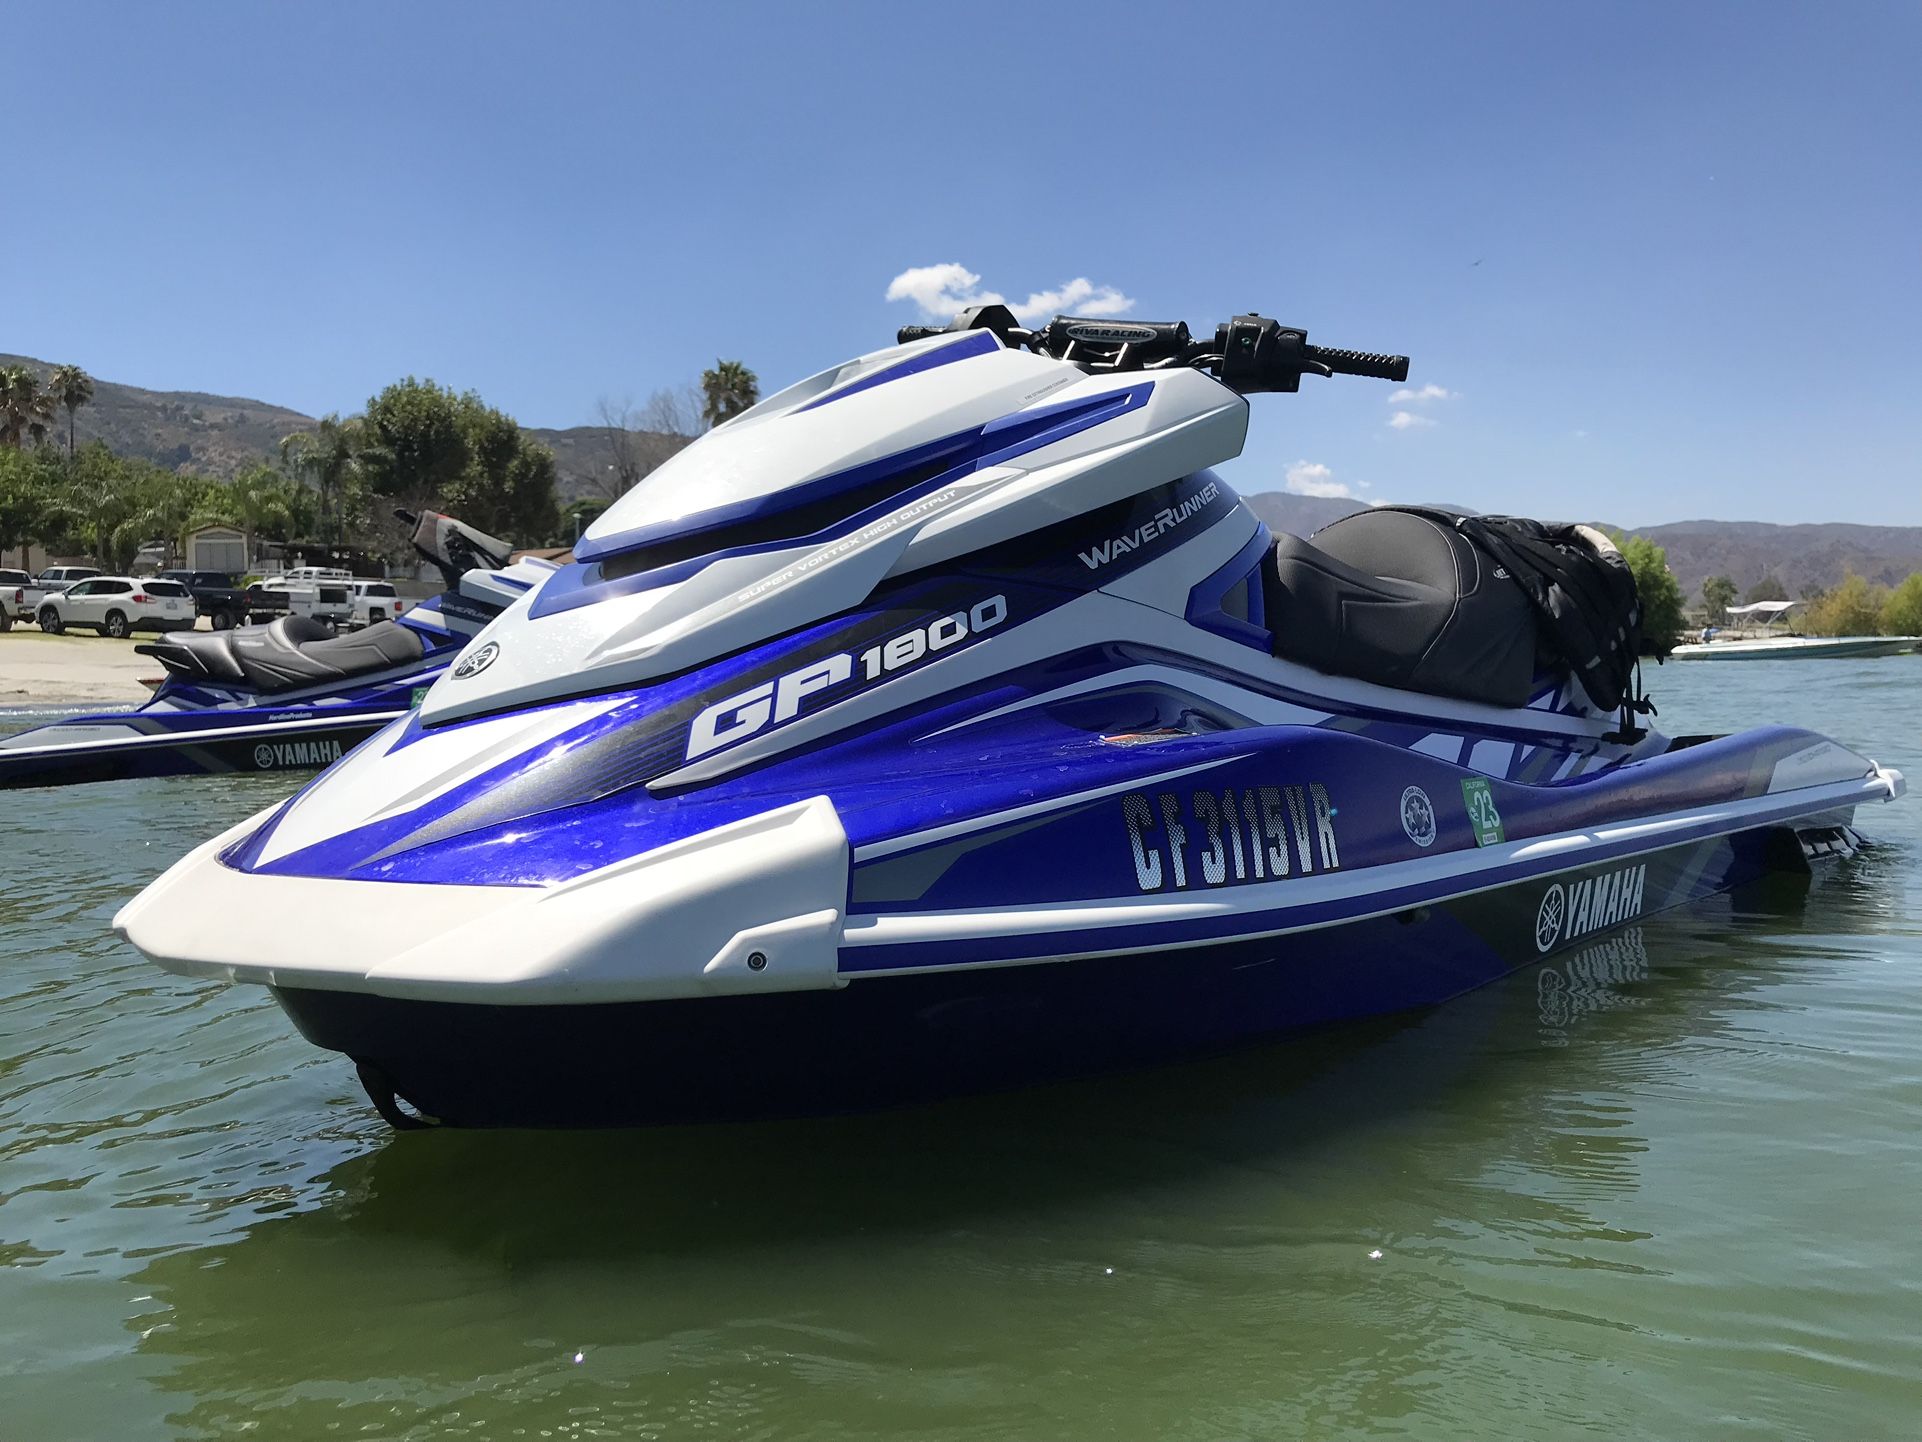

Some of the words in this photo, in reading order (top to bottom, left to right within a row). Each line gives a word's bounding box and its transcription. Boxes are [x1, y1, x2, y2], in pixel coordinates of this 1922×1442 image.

[737, 569, 793, 602] SUPER
[798, 536, 860, 572] VORTEX
[863, 517, 897, 539] HIGH
[900, 489, 957, 521] OUTPUT
[273, 740, 343, 766] YAMAHA
[1122, 793, 1186, 890] CF
[1193, 782, 1339, 884] 3115VR
[1474, 790, 1500, 829] 23
[1564, 863, 1646, 940] YAMAHA
